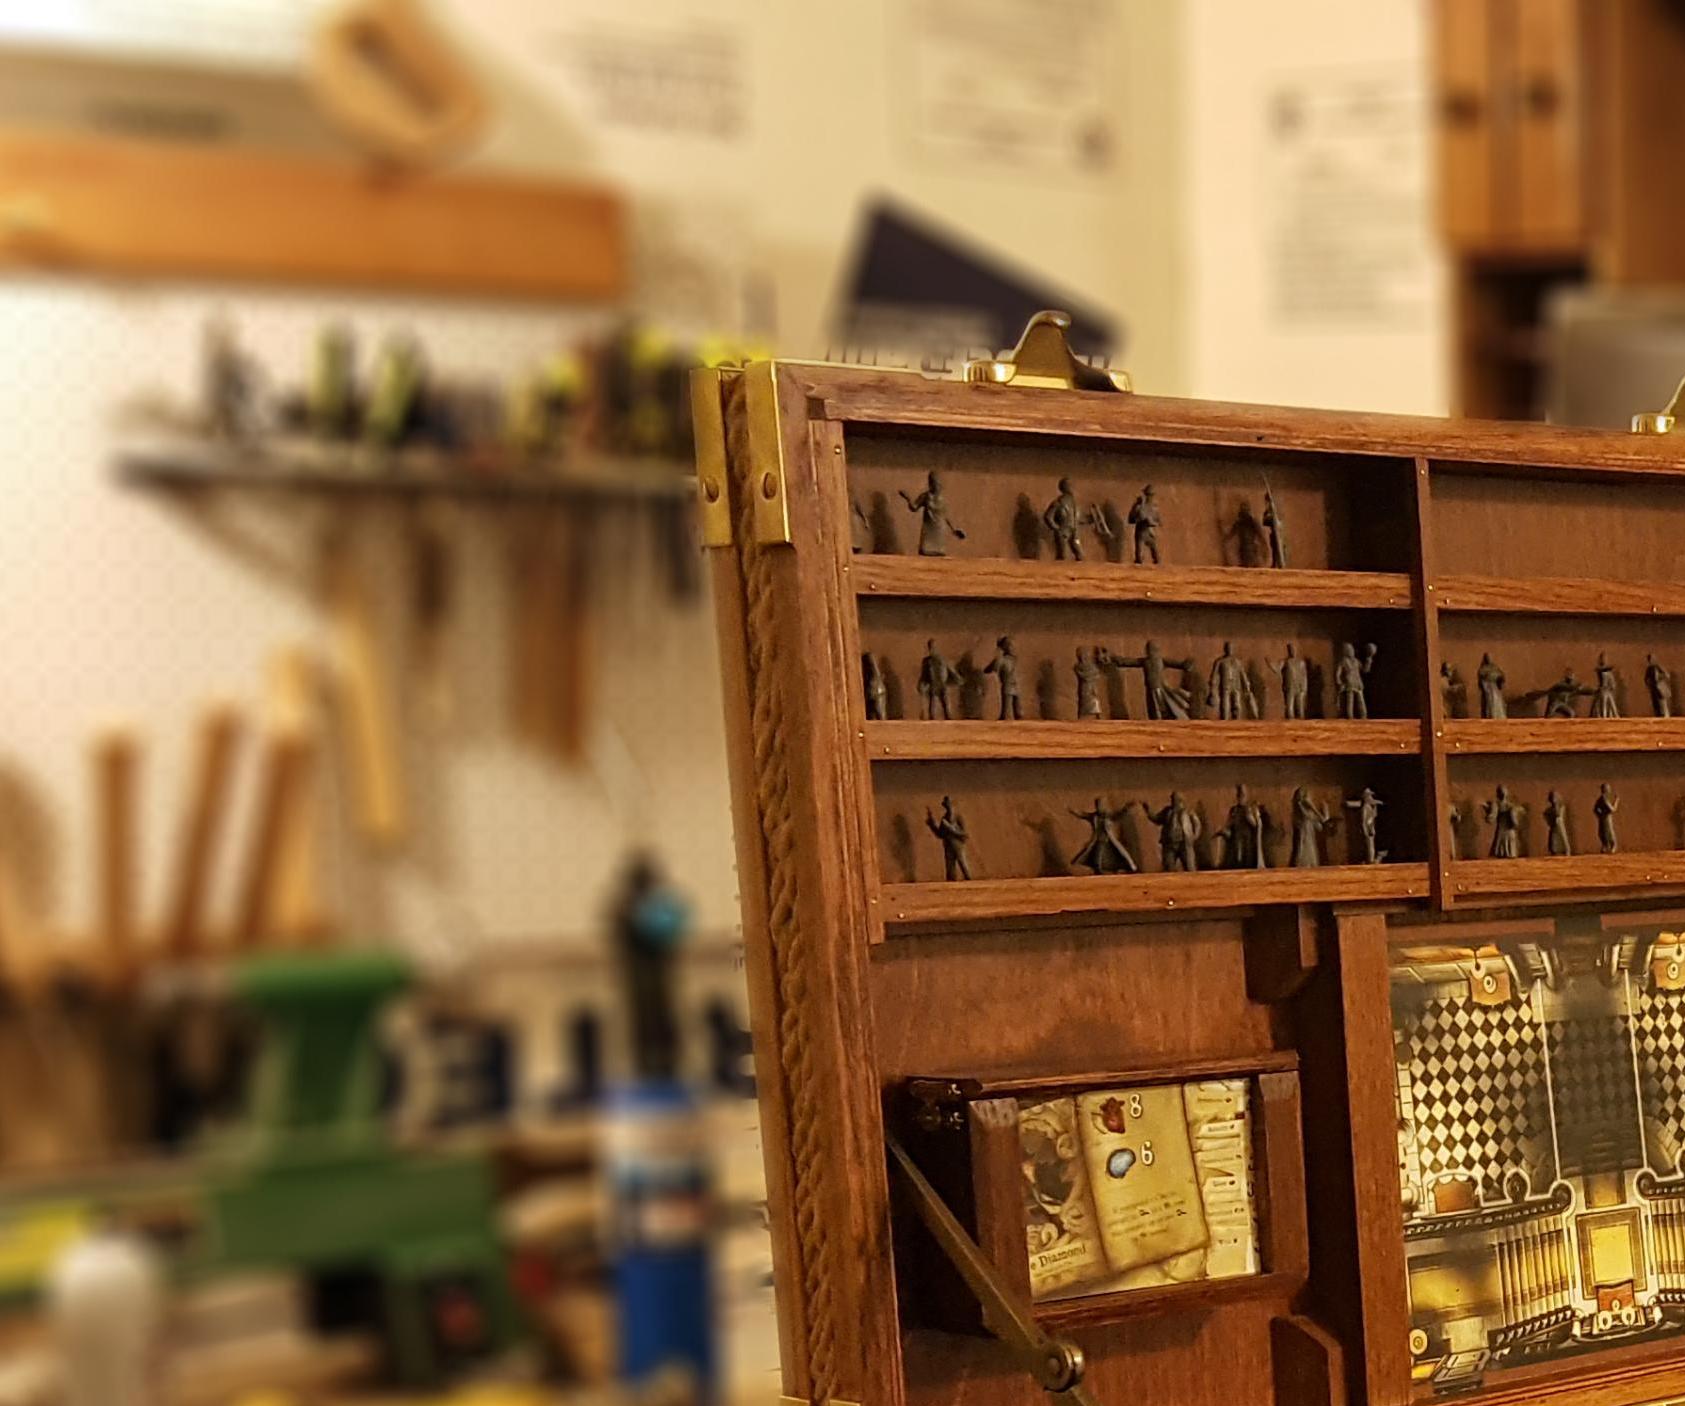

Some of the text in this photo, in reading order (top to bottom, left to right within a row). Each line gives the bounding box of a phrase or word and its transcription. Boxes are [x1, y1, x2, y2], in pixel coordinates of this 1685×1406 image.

[1130, 1093, 1142, 1118] 8
[1141, 1140, 1154, 1165] 6
[1038, 1243, 1086, 1268] Diamond
